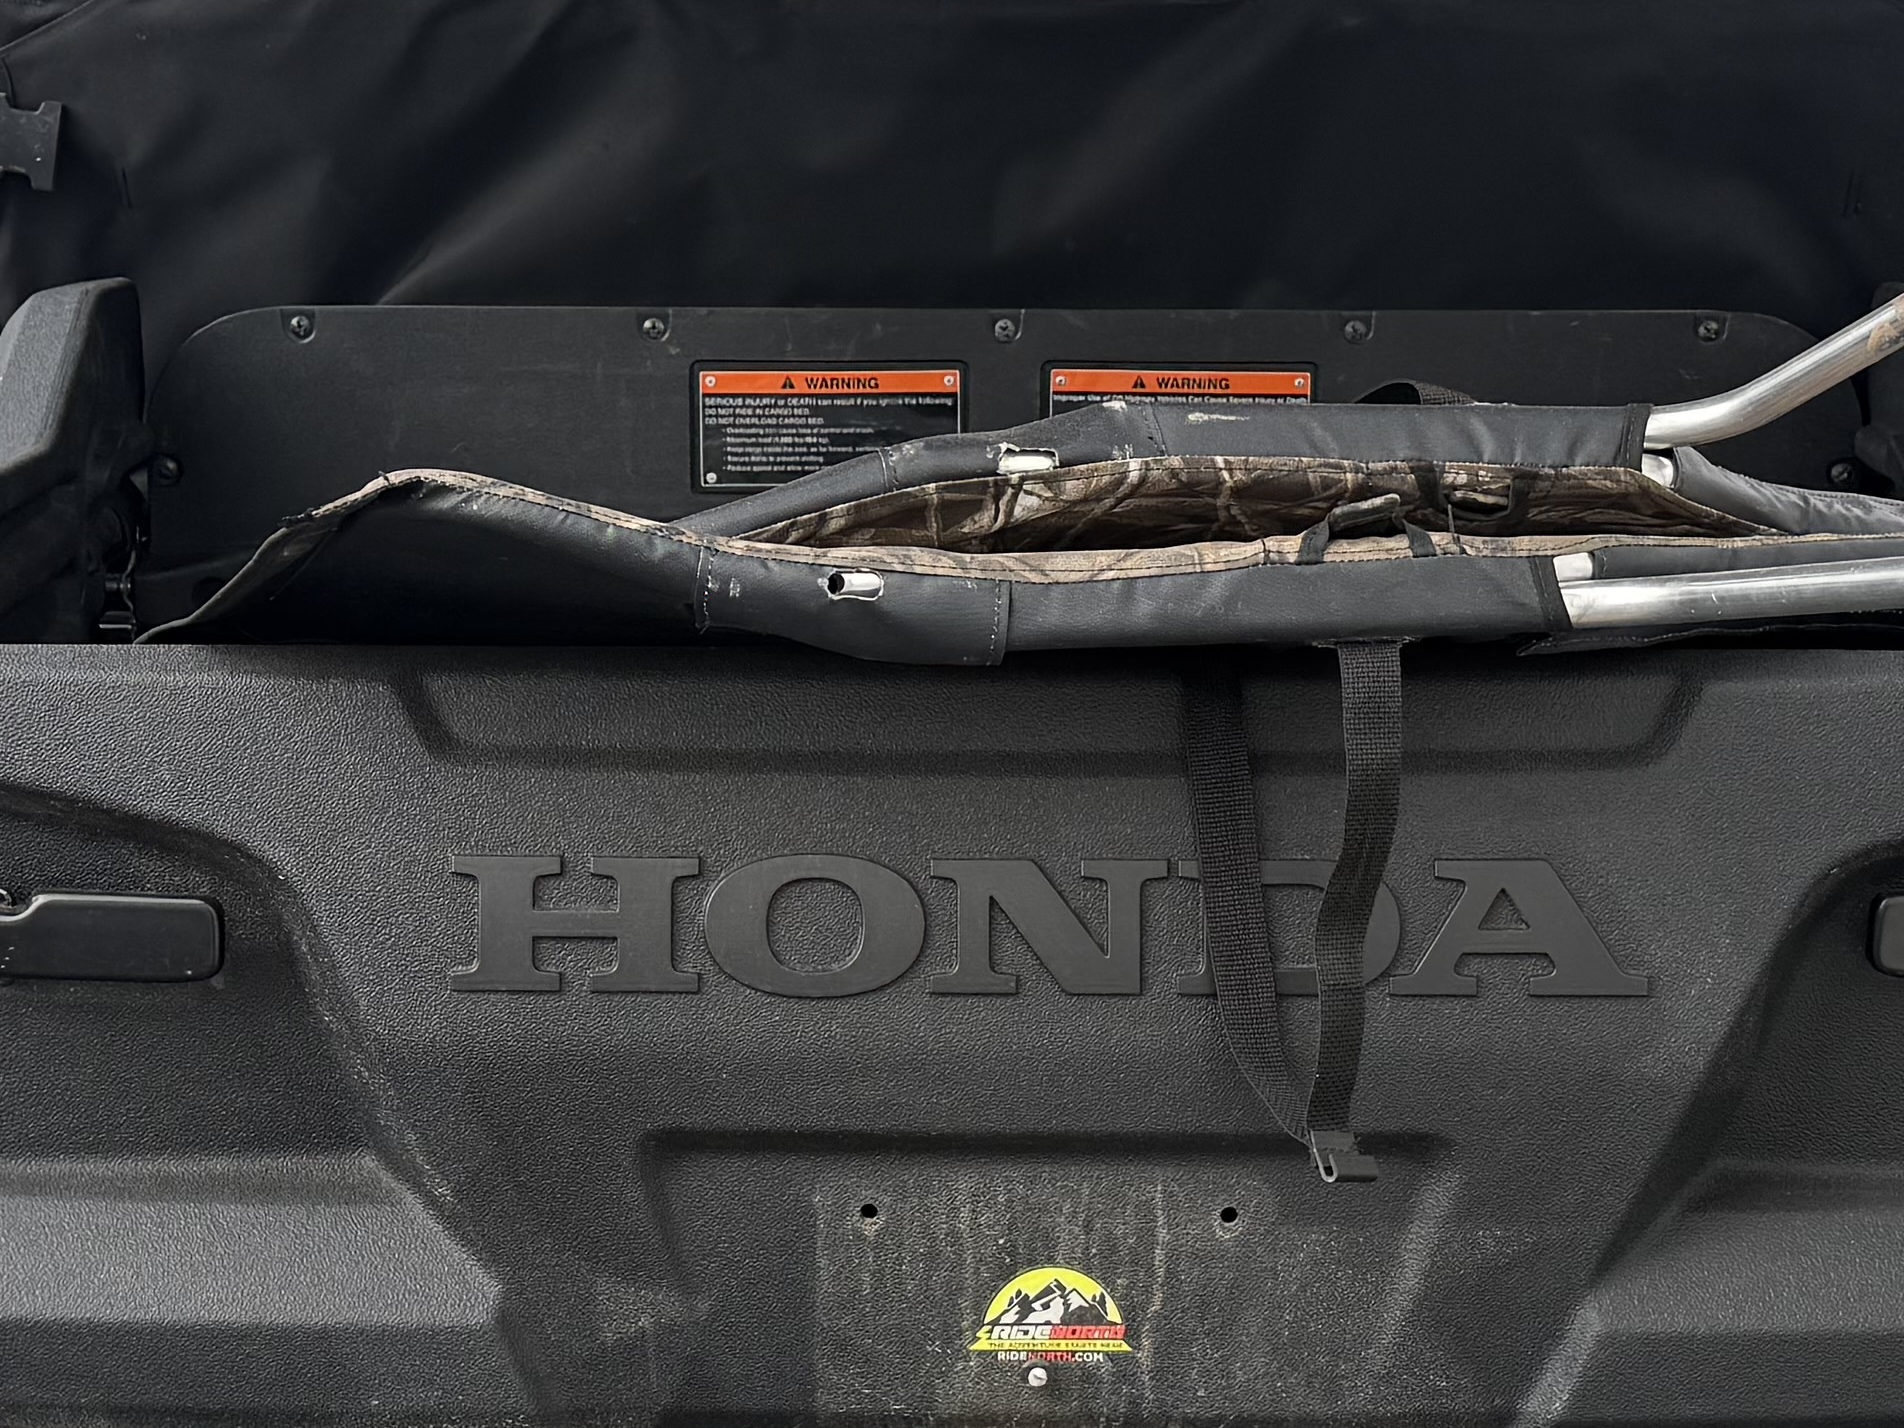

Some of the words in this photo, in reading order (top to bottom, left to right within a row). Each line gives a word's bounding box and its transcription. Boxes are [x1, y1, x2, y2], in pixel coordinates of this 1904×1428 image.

[805, 376, 880, 390] WARNING
[1156, 376, 1231, 390] WARNING
[448, 852, 1655, 1001] HONDA
[990, 1324, 1127, 1340] RIDENORTH
[1008, 1342, 1061, 1350] ADVENTURE
[997, 1351, 1104, 1362] RIDENORTH.COM
